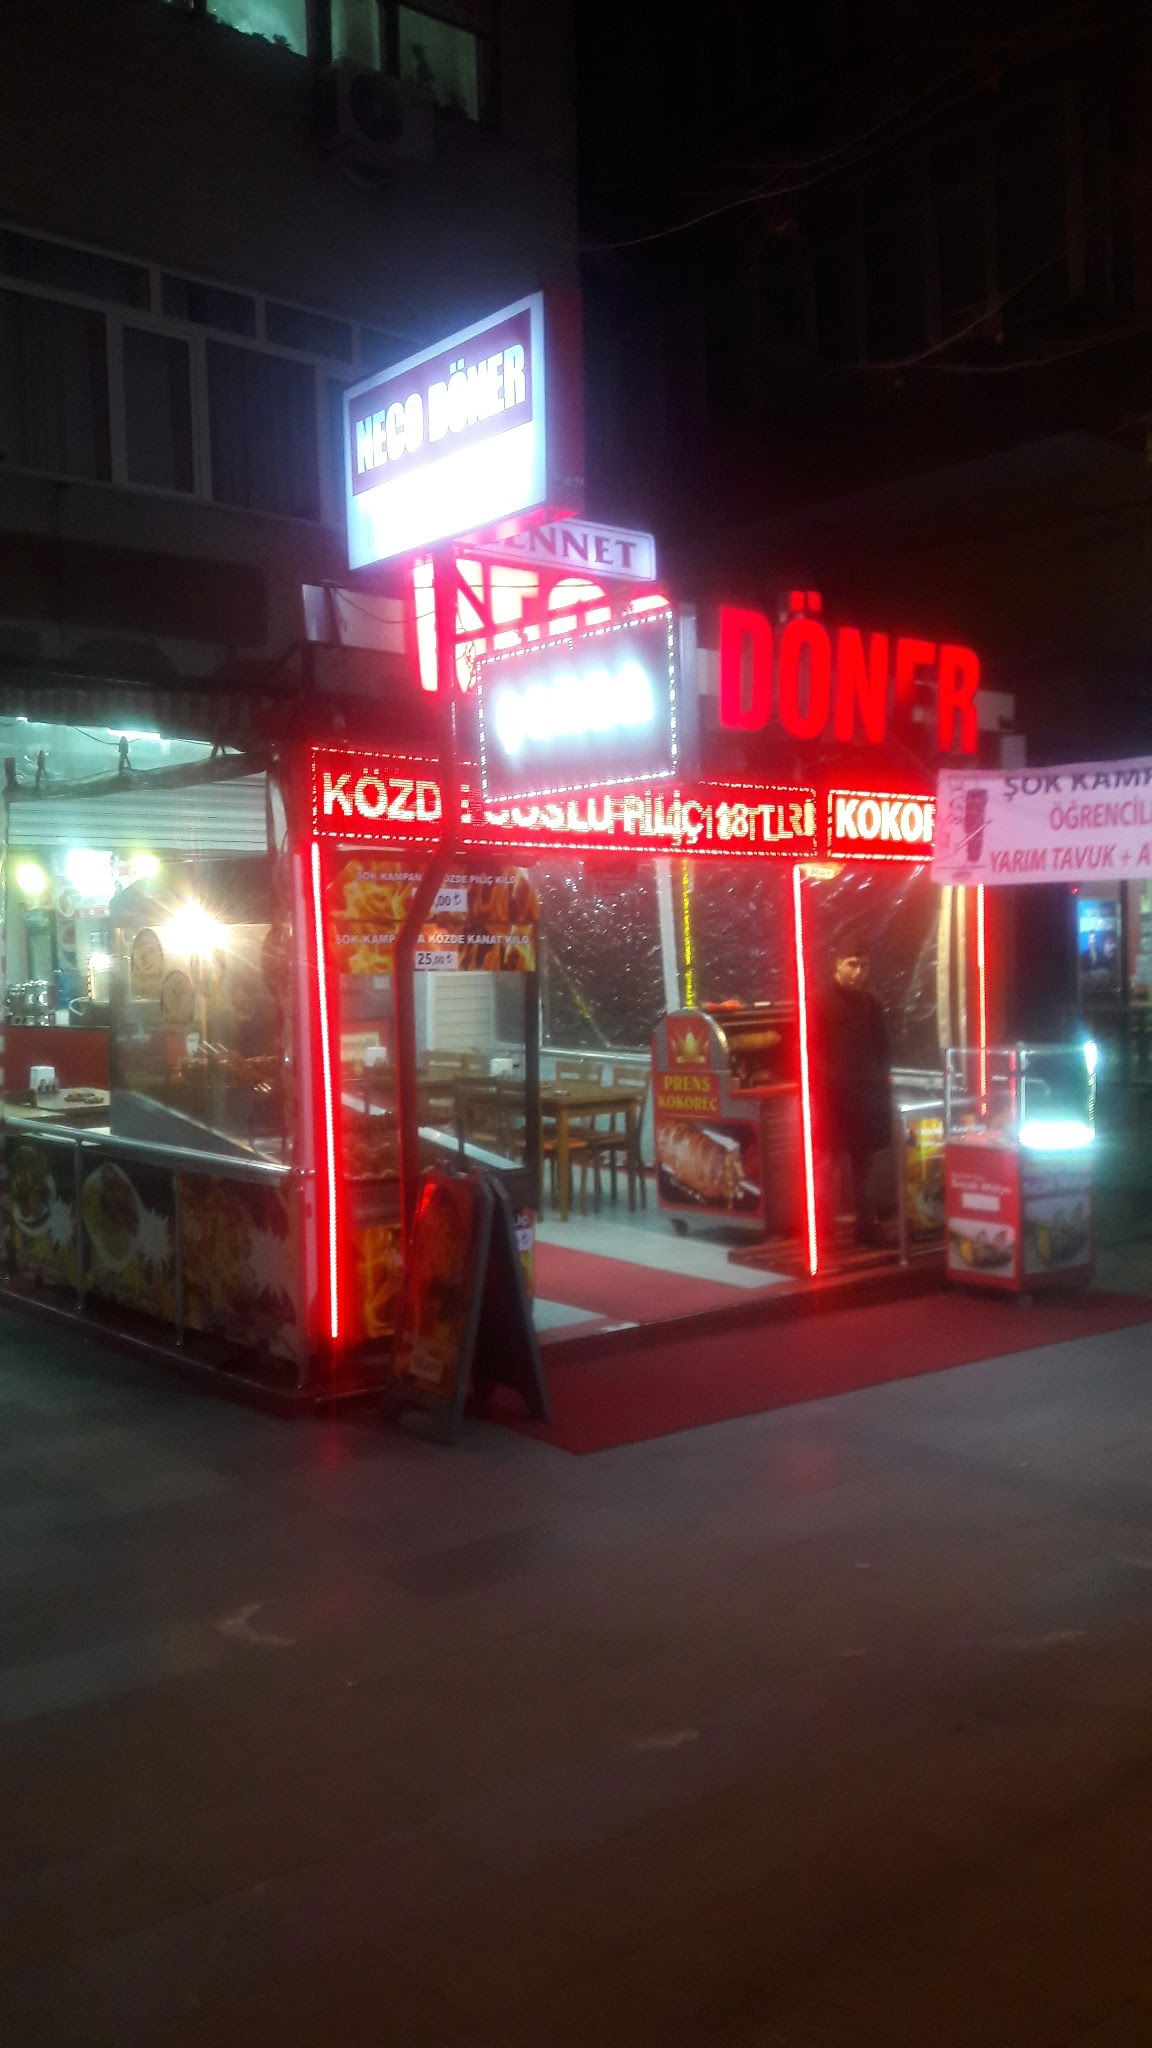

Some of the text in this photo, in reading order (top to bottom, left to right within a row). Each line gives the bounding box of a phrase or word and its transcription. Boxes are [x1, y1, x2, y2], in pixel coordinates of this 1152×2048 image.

[427, 344, 527, 444] DÖNER
[719, 590, 981, 756] DÖNER
[1003, 774, 1062, 803] ŞOK
[989, 848, 1047, 874] YARIM
[1053, 843, 1118, 870] TAVUK
